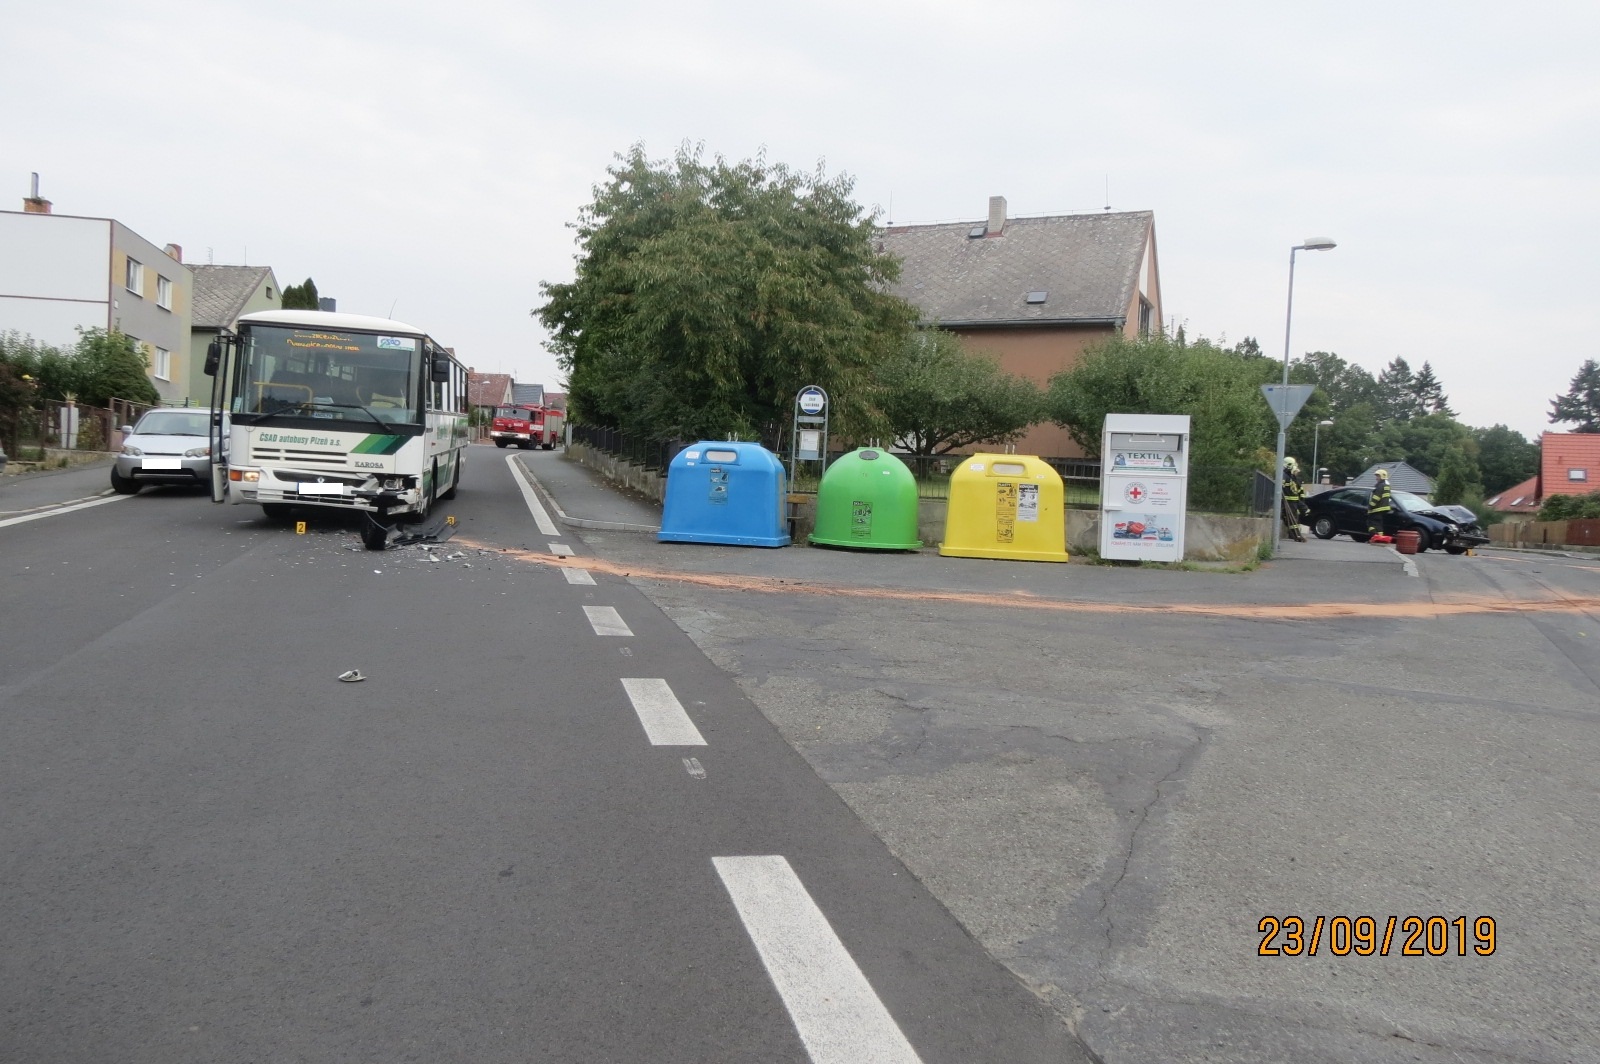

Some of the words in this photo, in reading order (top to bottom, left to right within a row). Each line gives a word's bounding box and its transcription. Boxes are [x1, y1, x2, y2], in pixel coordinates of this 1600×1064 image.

[259, 432, 278, 442] ČSAD
[279, 435, 309, 445] autobusy
[309, 436, 328, 445] Plzeň
[1127, 452, 1162, 460] TEXTIL
[354, 461, 384, 469] KAROSA
[298, 523, 304, 533] 2
